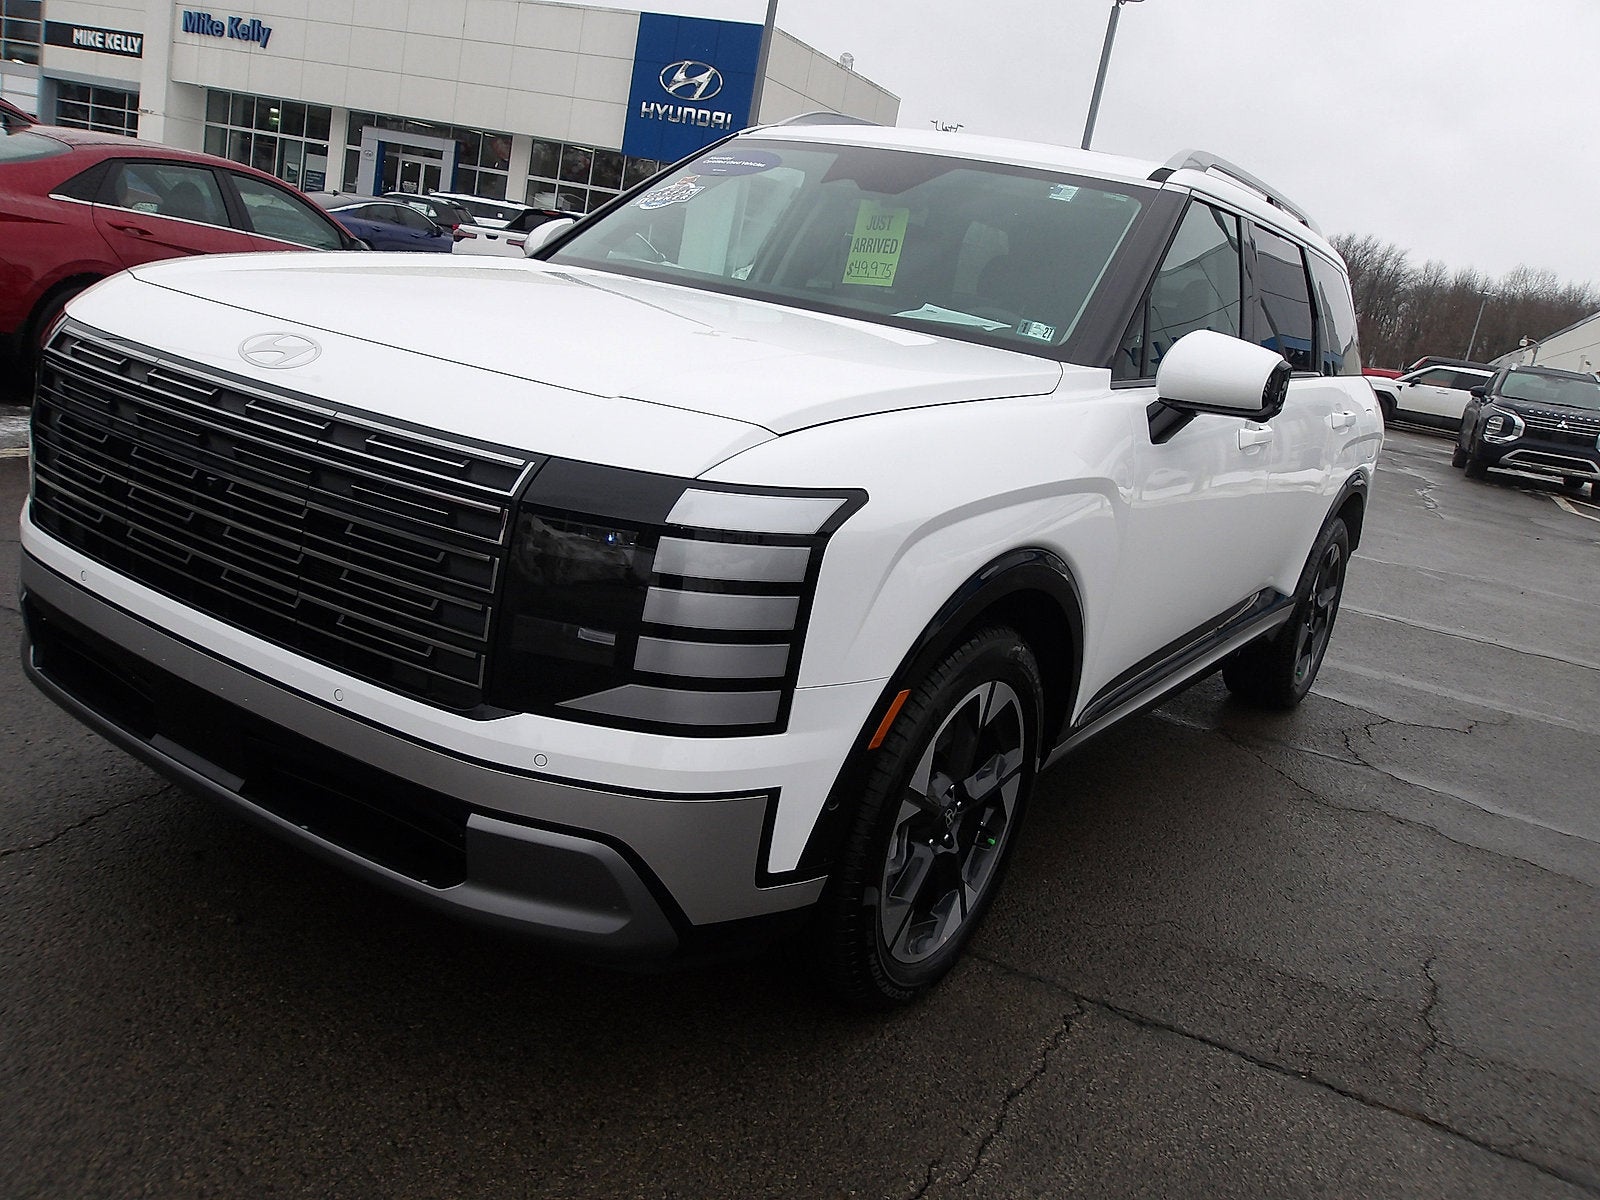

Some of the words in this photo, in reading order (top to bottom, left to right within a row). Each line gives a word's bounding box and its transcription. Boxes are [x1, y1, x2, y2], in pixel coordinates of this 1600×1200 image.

[72, 27, 104, 48] MIKE
[104, 32, 142, 53] KELLY
[182, 10, 225, 38] Mike
[227, 15, 272, 49] Kelly
[640, 101, 733, 130] HYUNDAI
[865, 214, 895, 232] JUST
[852, 237, 899, 255] ARRIVED
[846, 260, 893, 279] $49,975
